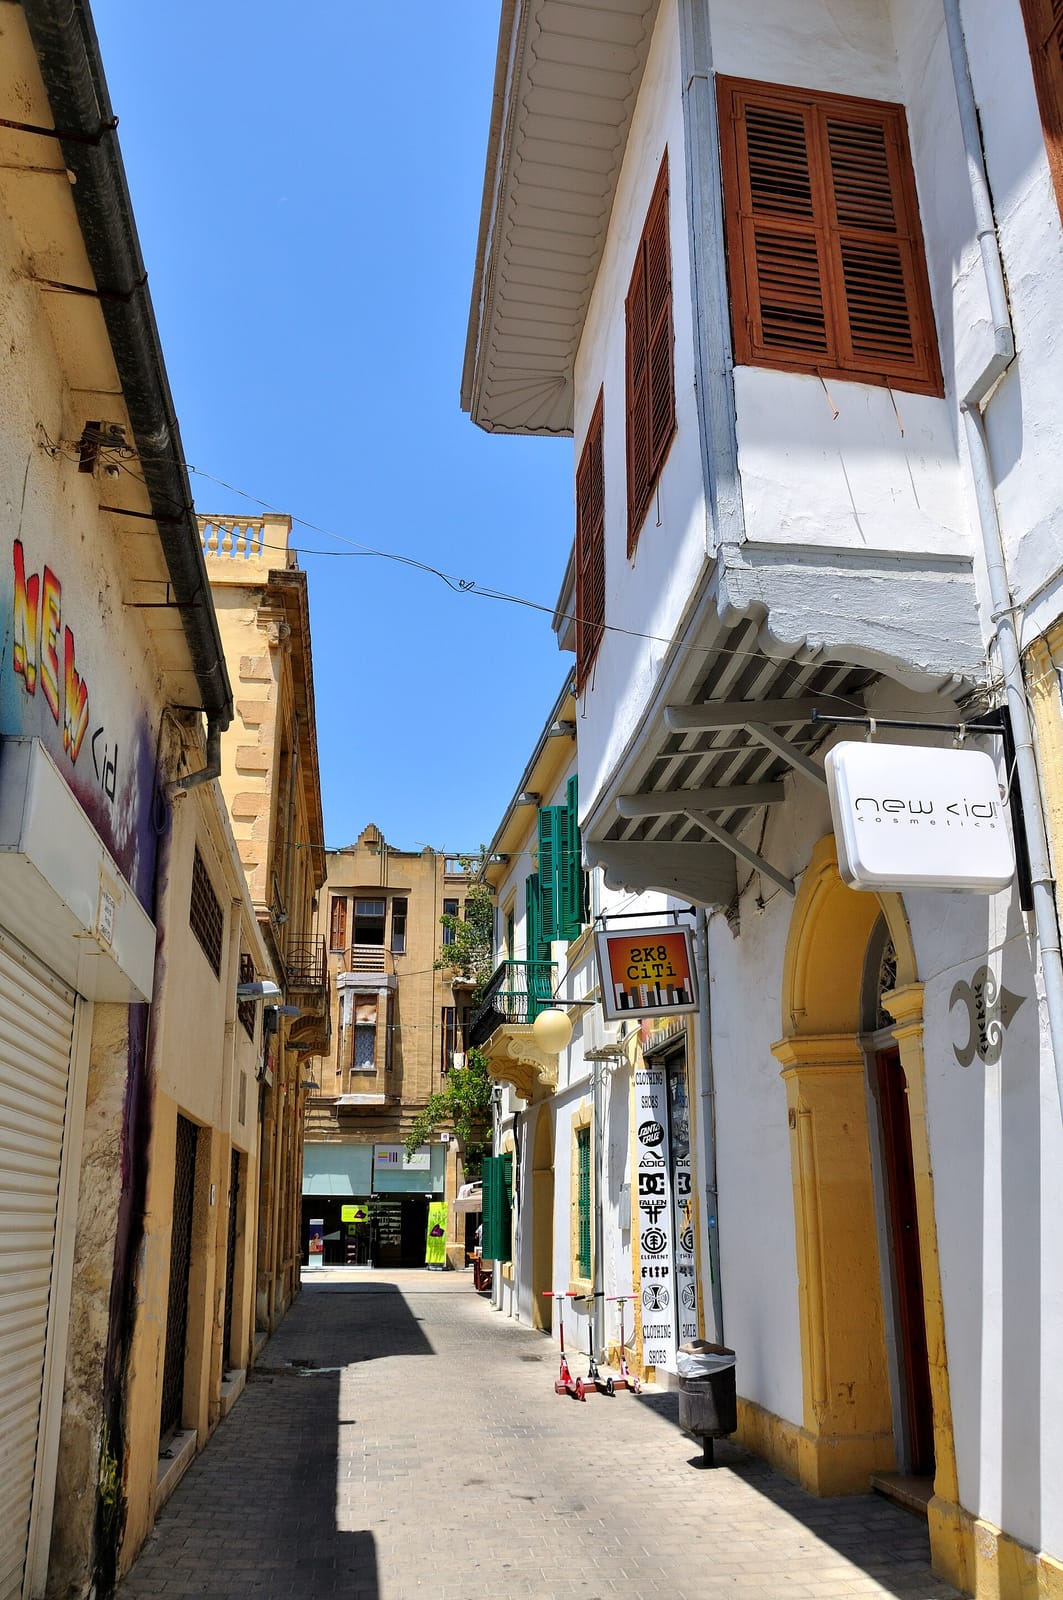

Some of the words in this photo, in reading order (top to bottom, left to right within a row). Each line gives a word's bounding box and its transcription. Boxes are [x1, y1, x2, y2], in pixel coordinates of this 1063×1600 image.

[855, 797, 934, 815] new
[857, 816, 996, 829] cosmetics
[635, 1071, 663, 1085] CLOTHING
[639, 1160, 666, 1168] ADIO
[638, 1173, 665, 1195] DC
[643, 1324, 672, 1339] CLOTHING
[648, 1350, 667, 1364] SHOES
